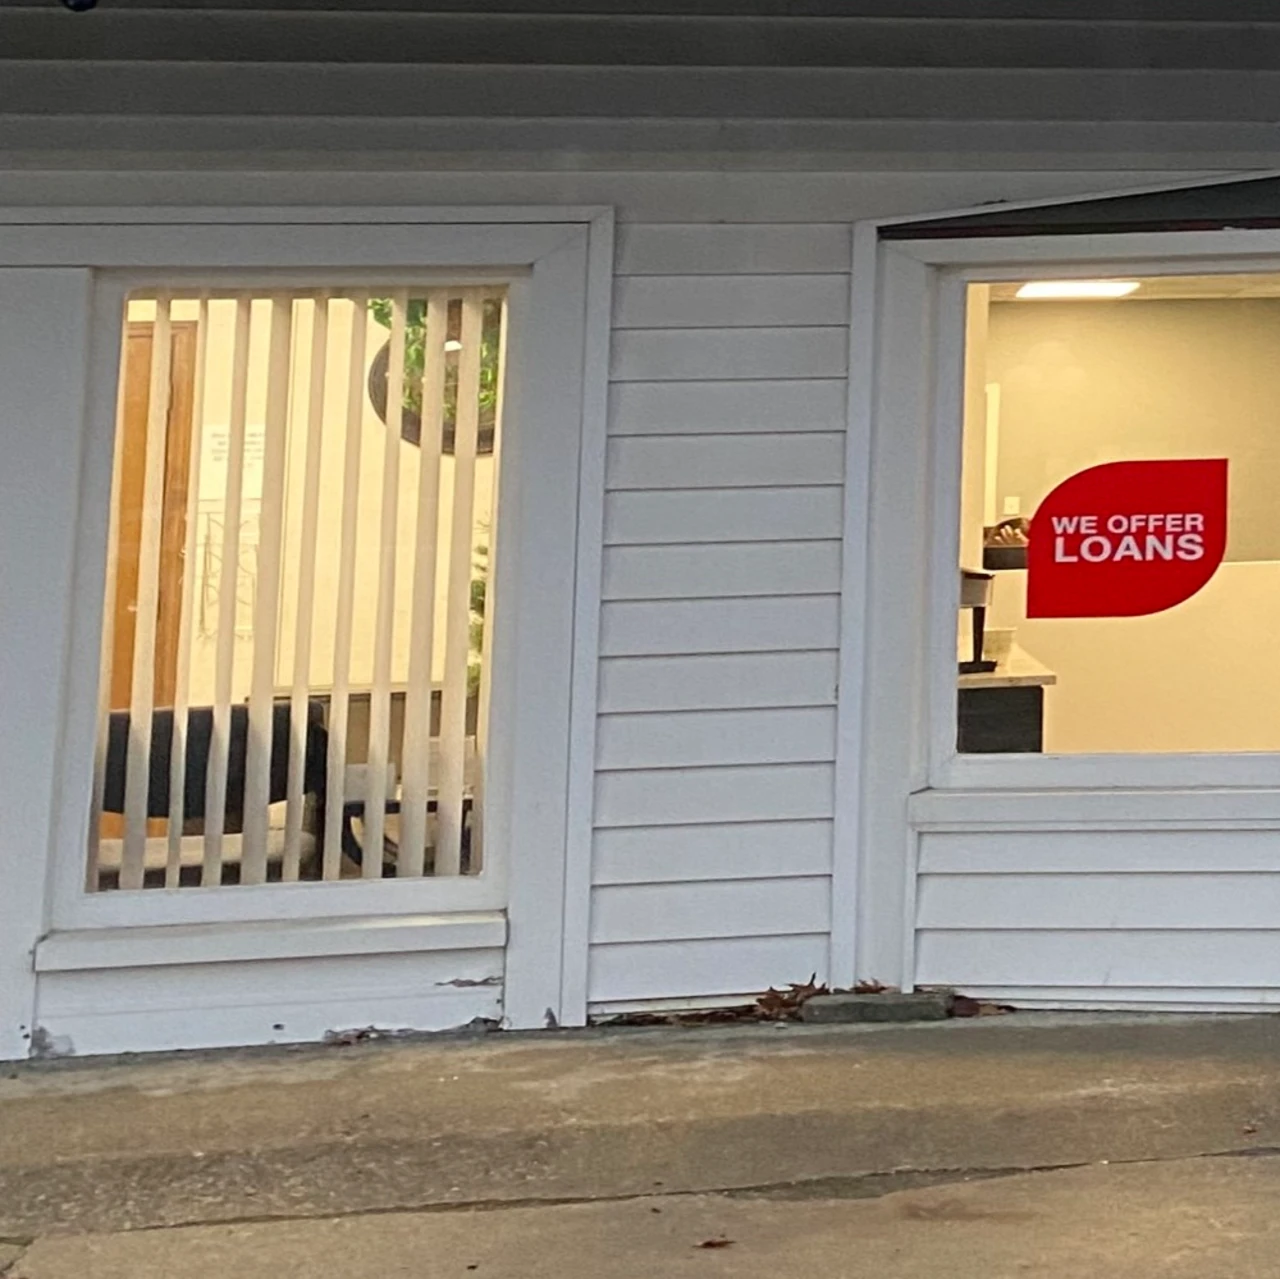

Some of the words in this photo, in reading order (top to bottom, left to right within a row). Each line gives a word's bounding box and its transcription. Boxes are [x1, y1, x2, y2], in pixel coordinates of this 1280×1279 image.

[1051, 515, 1099, 535] WE
[1106, 513, 1205, 534] OFFER
[1054, 533, 1205, 563] LOANS
